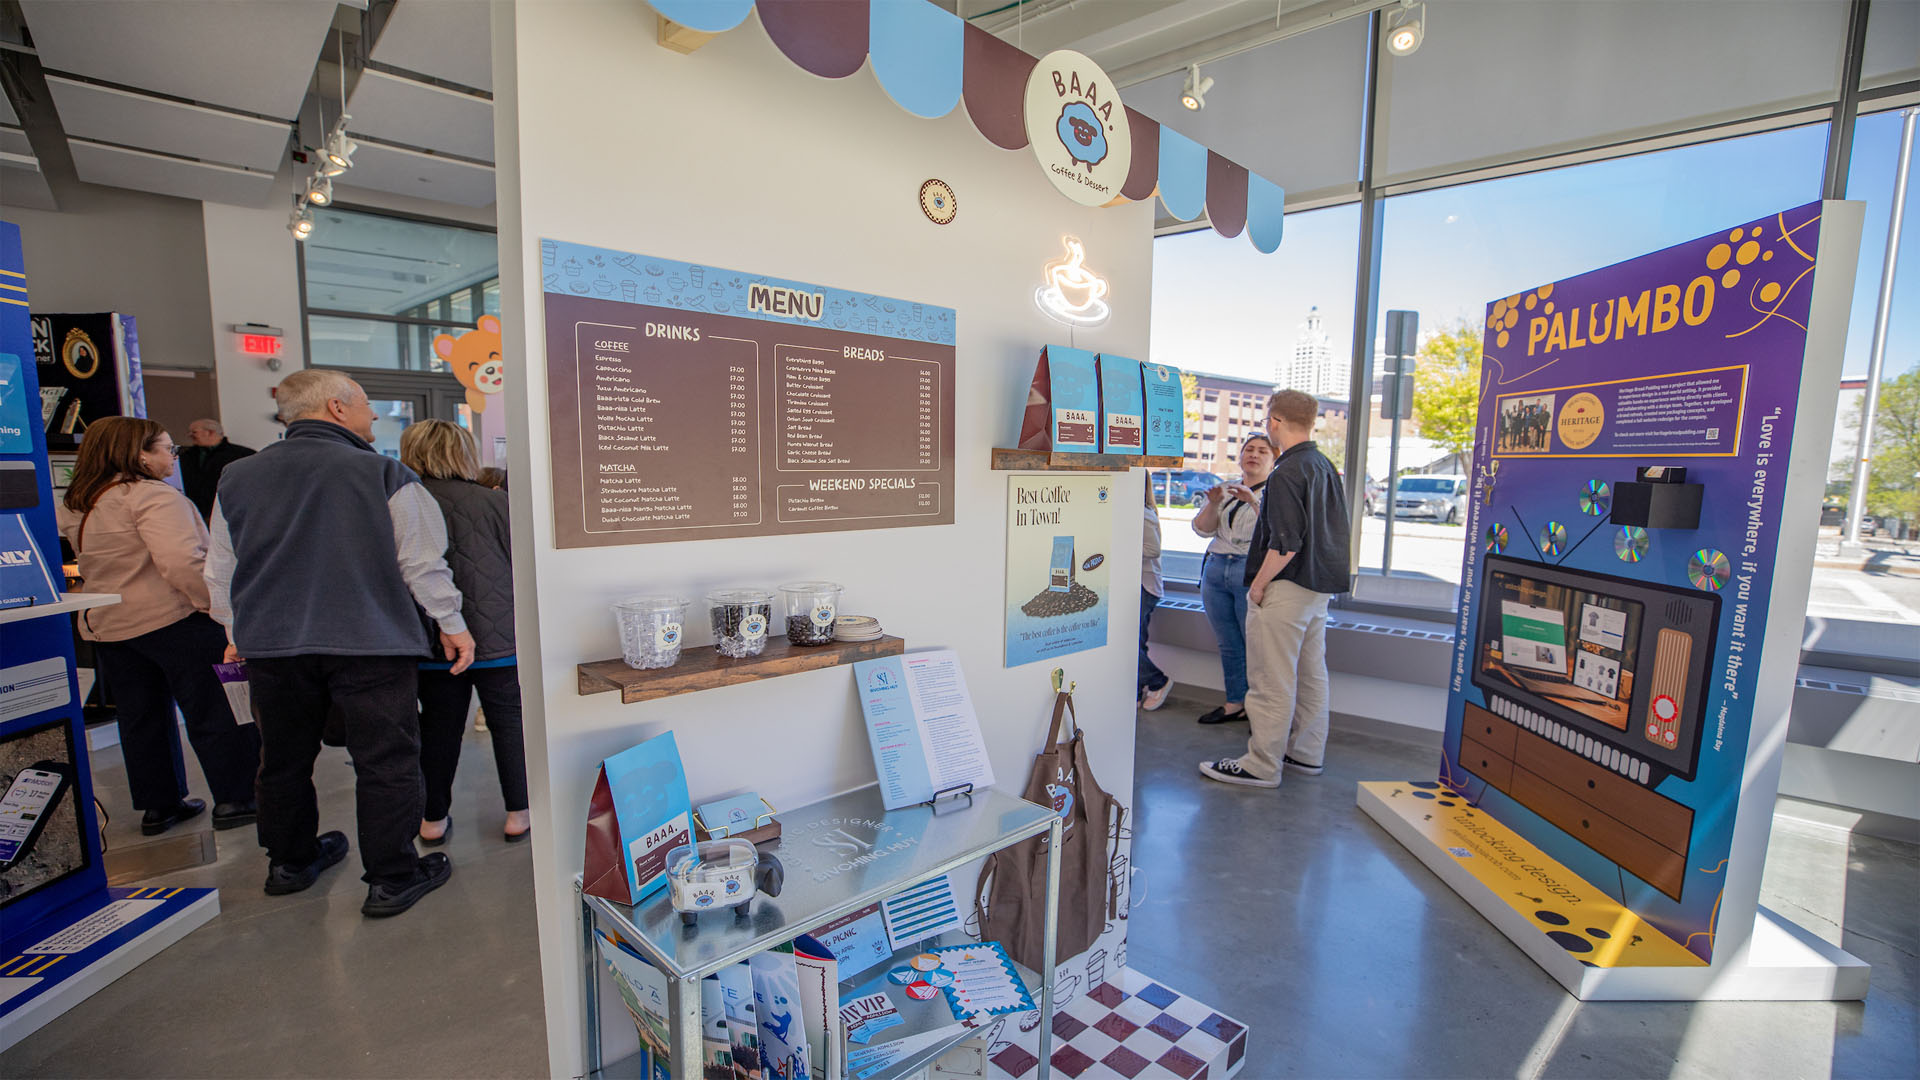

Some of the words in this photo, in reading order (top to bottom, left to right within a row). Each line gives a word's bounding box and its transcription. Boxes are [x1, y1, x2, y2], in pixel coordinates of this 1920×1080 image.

[1052, 70, 1114, 131] BAAA.
[1051, 164, 1077, 182] Coffee
[1077, 176, 1084, 186] &
[1084, 175, 1109, 194] Dessert
[751, 287, 821, 318] MENU
[1527, 275, 1715, 357] PALUMBO
[645, 323, 700, 341] DRINKS
[243, 335, 277, 354] EXIT
[594, 339, 629, 350] COFFEE
[843, 346, 885, 361] BREADS
[1560, 416, 1601, 426] HERITAGE
[1758, 406, 1782, 448] “Love
[598, 462, 636, 472] MATCHA
[1756, 453, 1773, 466] is
[809, 477, 865, 492] WEEKEND
[868, 476, 915, 490] SPECIALS
[1017, 486, 1039, 504] Best
[1040, 485, 1071, 504] Coffee
[1016, 509, 1027, 526] In
[1029, 508, 1061, 525] Town!
[1469, 500, 1482, 544] wherever
[1740, 470, 1768, 558] everywhere,
[1466, 545, 1477, 565] love
[1742, 561, 1758, 573] if
[1466, 566, 1476, 588] your
[1464, 589, 1472, 604] for
[1736, 575, 1752, 601] you
[1460, 605, 1471, 636] search
[1731, 604, 1749, 638] want
[1730, 641, 1746, 651] it
[1457, 652, 1466, 674] goes
[1453, 675, 1463, 692] Life
[1716, 706, 1728, 739] Magdalena
[1713, 739, 1723, 752] Bay
[806, 818, 894, 833] DESIGNER
[646, 824, 678, 848] BAAA.
[1453, 815, 1525, 864] unlocking
[1521, 862, 1582, 907] design.
[832, 928, 857, 944] PICNIC
[857, 995, 886, 1013] VIP
